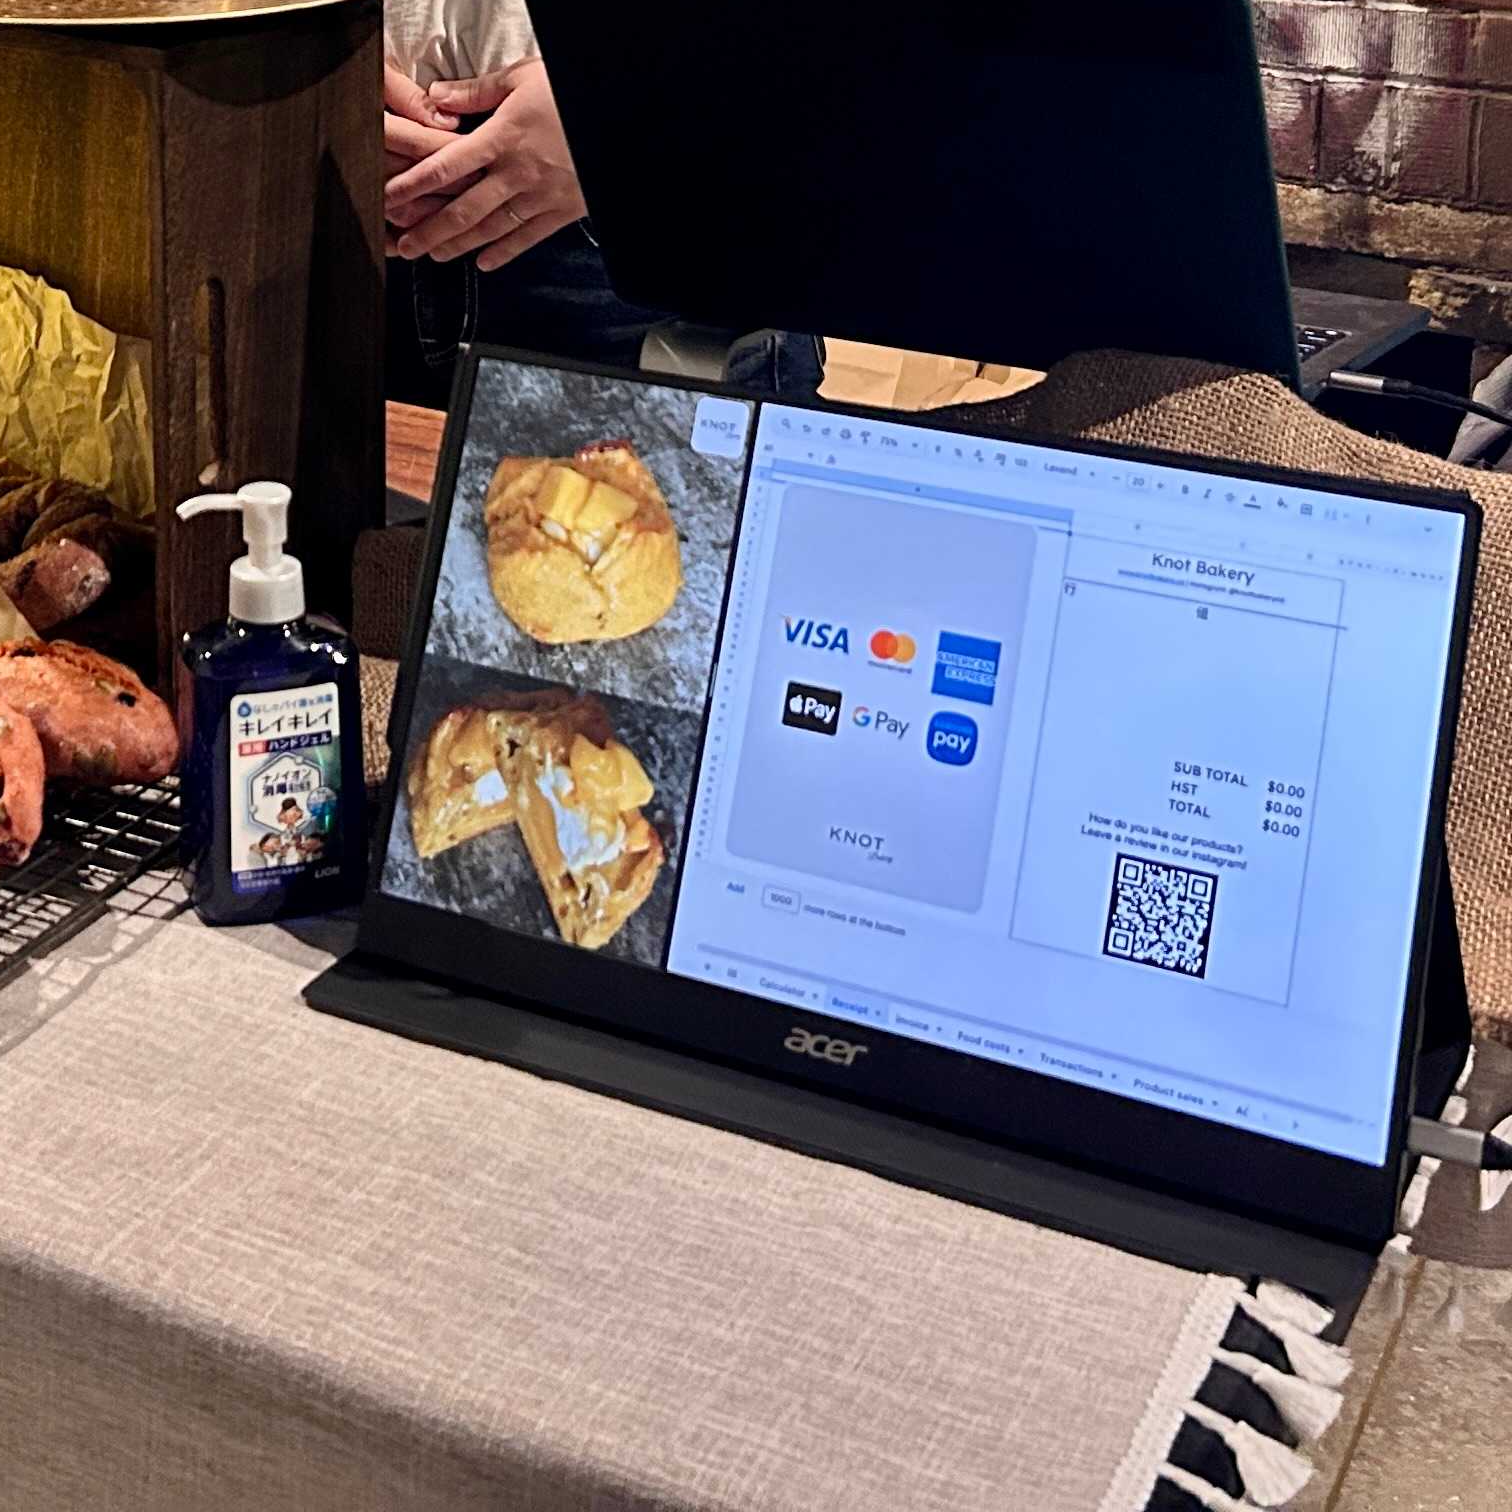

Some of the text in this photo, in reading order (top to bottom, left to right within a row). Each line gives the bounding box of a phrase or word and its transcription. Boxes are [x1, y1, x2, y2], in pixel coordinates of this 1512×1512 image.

[1151, 553, 1191, 572] Knot
[1196, 560, 1256, 586] Bakery
[784, 615, 850, 655] VISA
[239, 708, 333, 737] キレイキレイ
[803, 696, 837, 725] Pay
[874, 710, 911, 739] Pay
[932, 729, 972, 754] pay
[1174, 760, 1306, 800] SUB TOTAL $0.00
[1170, 780, 1304, 819] HST $0.00
[1088, 811, 1244, 856] How do you like our products?
[1168, 798, 1301, 839] TOTAL $0.00
[829, 825, 886, 851] KNOT
[1124, 835, 1158, 851] review
[784, 1026, 869, 1067] acer
[1133, 1078, 1175, 1099] Product
